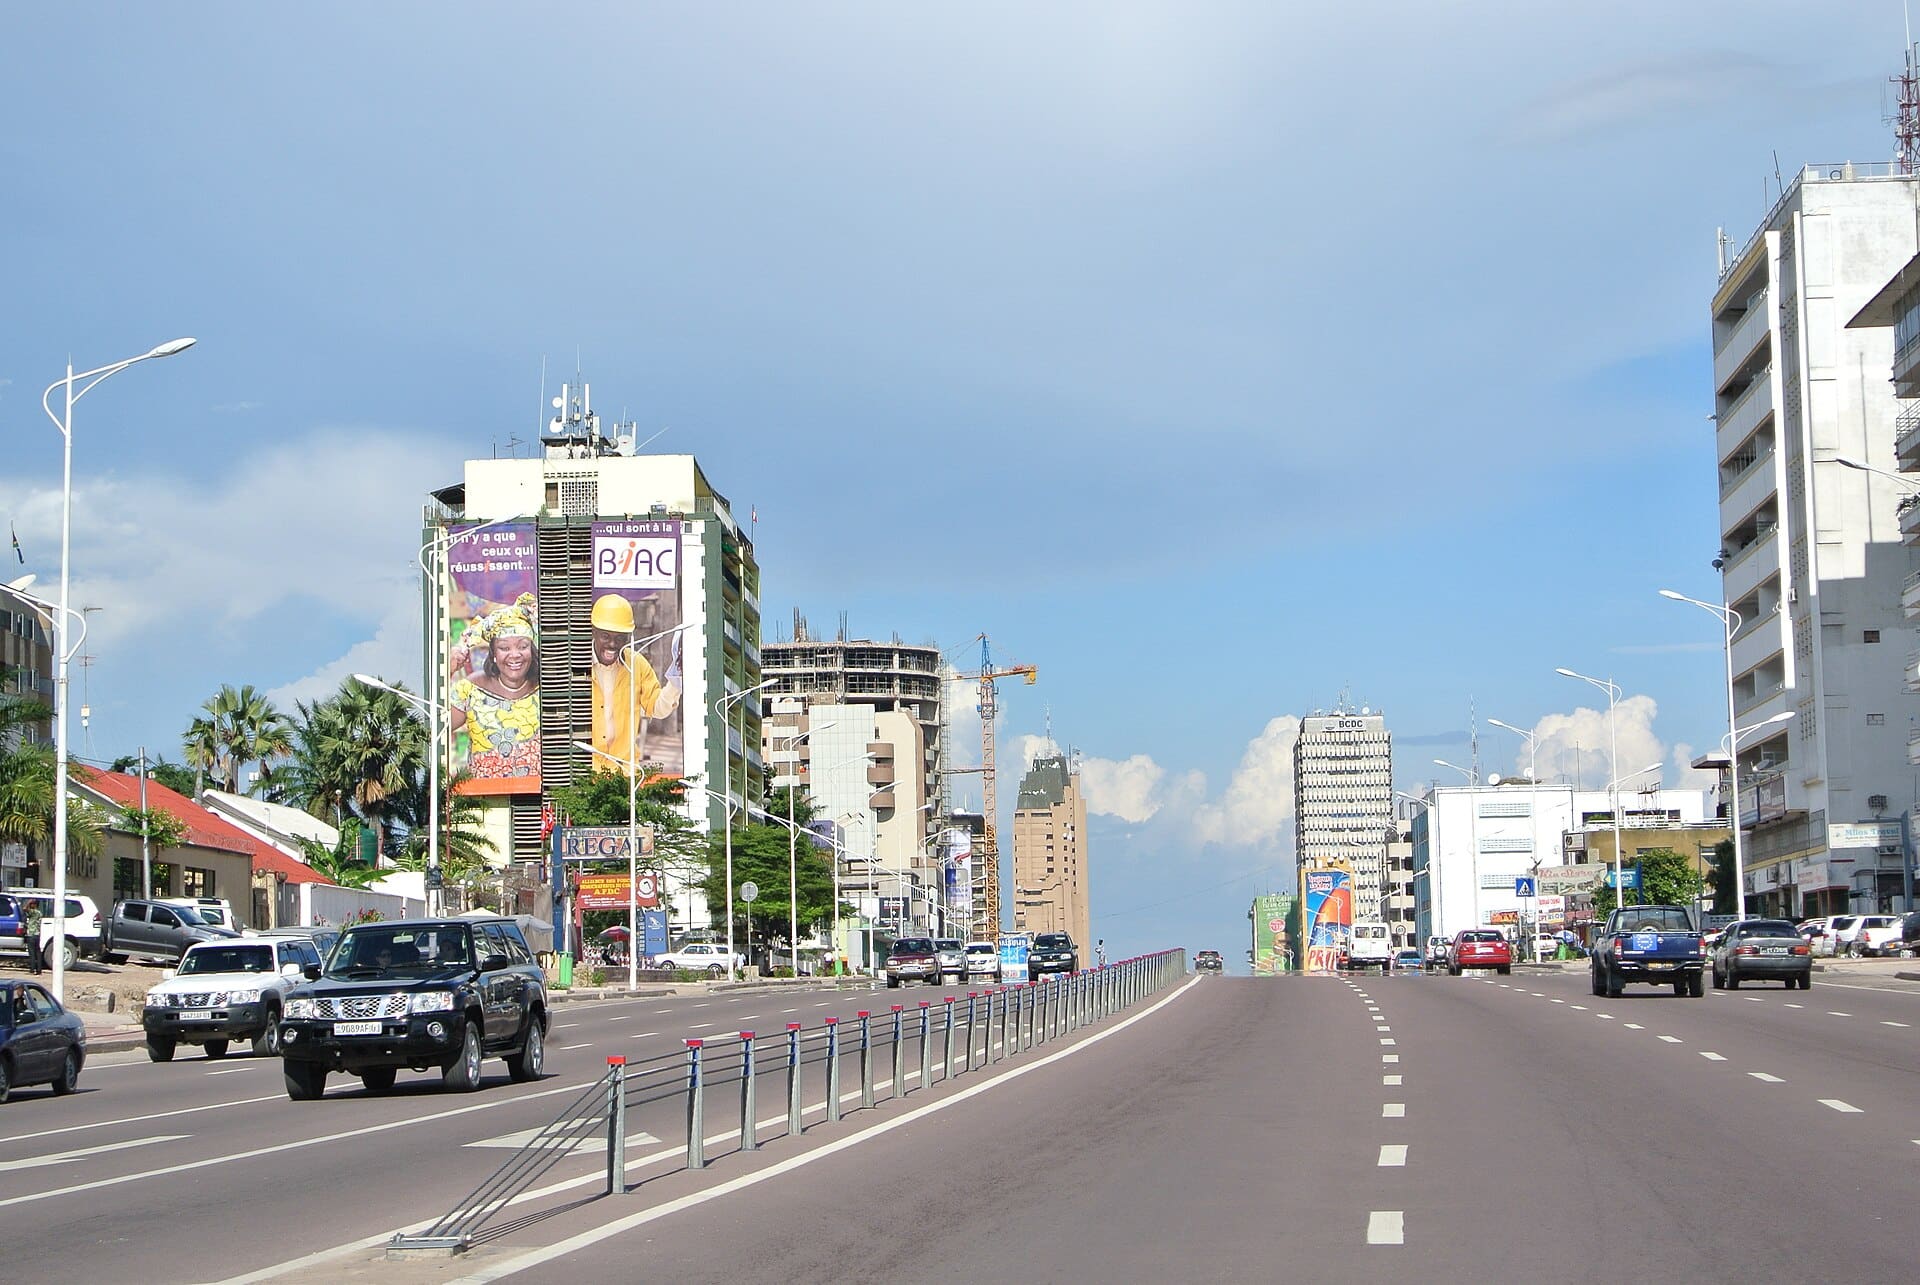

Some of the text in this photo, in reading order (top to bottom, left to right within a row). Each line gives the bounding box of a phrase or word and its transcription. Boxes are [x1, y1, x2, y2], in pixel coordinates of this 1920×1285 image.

[626, 523, 650, 533] sont
[653, 522, 660, 532] à
[662, 522, 672, 532] la
[482, 534, 490, 542] a
[493, 532, 516, 543] que
[481, 544, 534, 557] ceux qui
[1338, 720, 1363, 728] BCDC
[567, 837, 652, 856] REGAL
